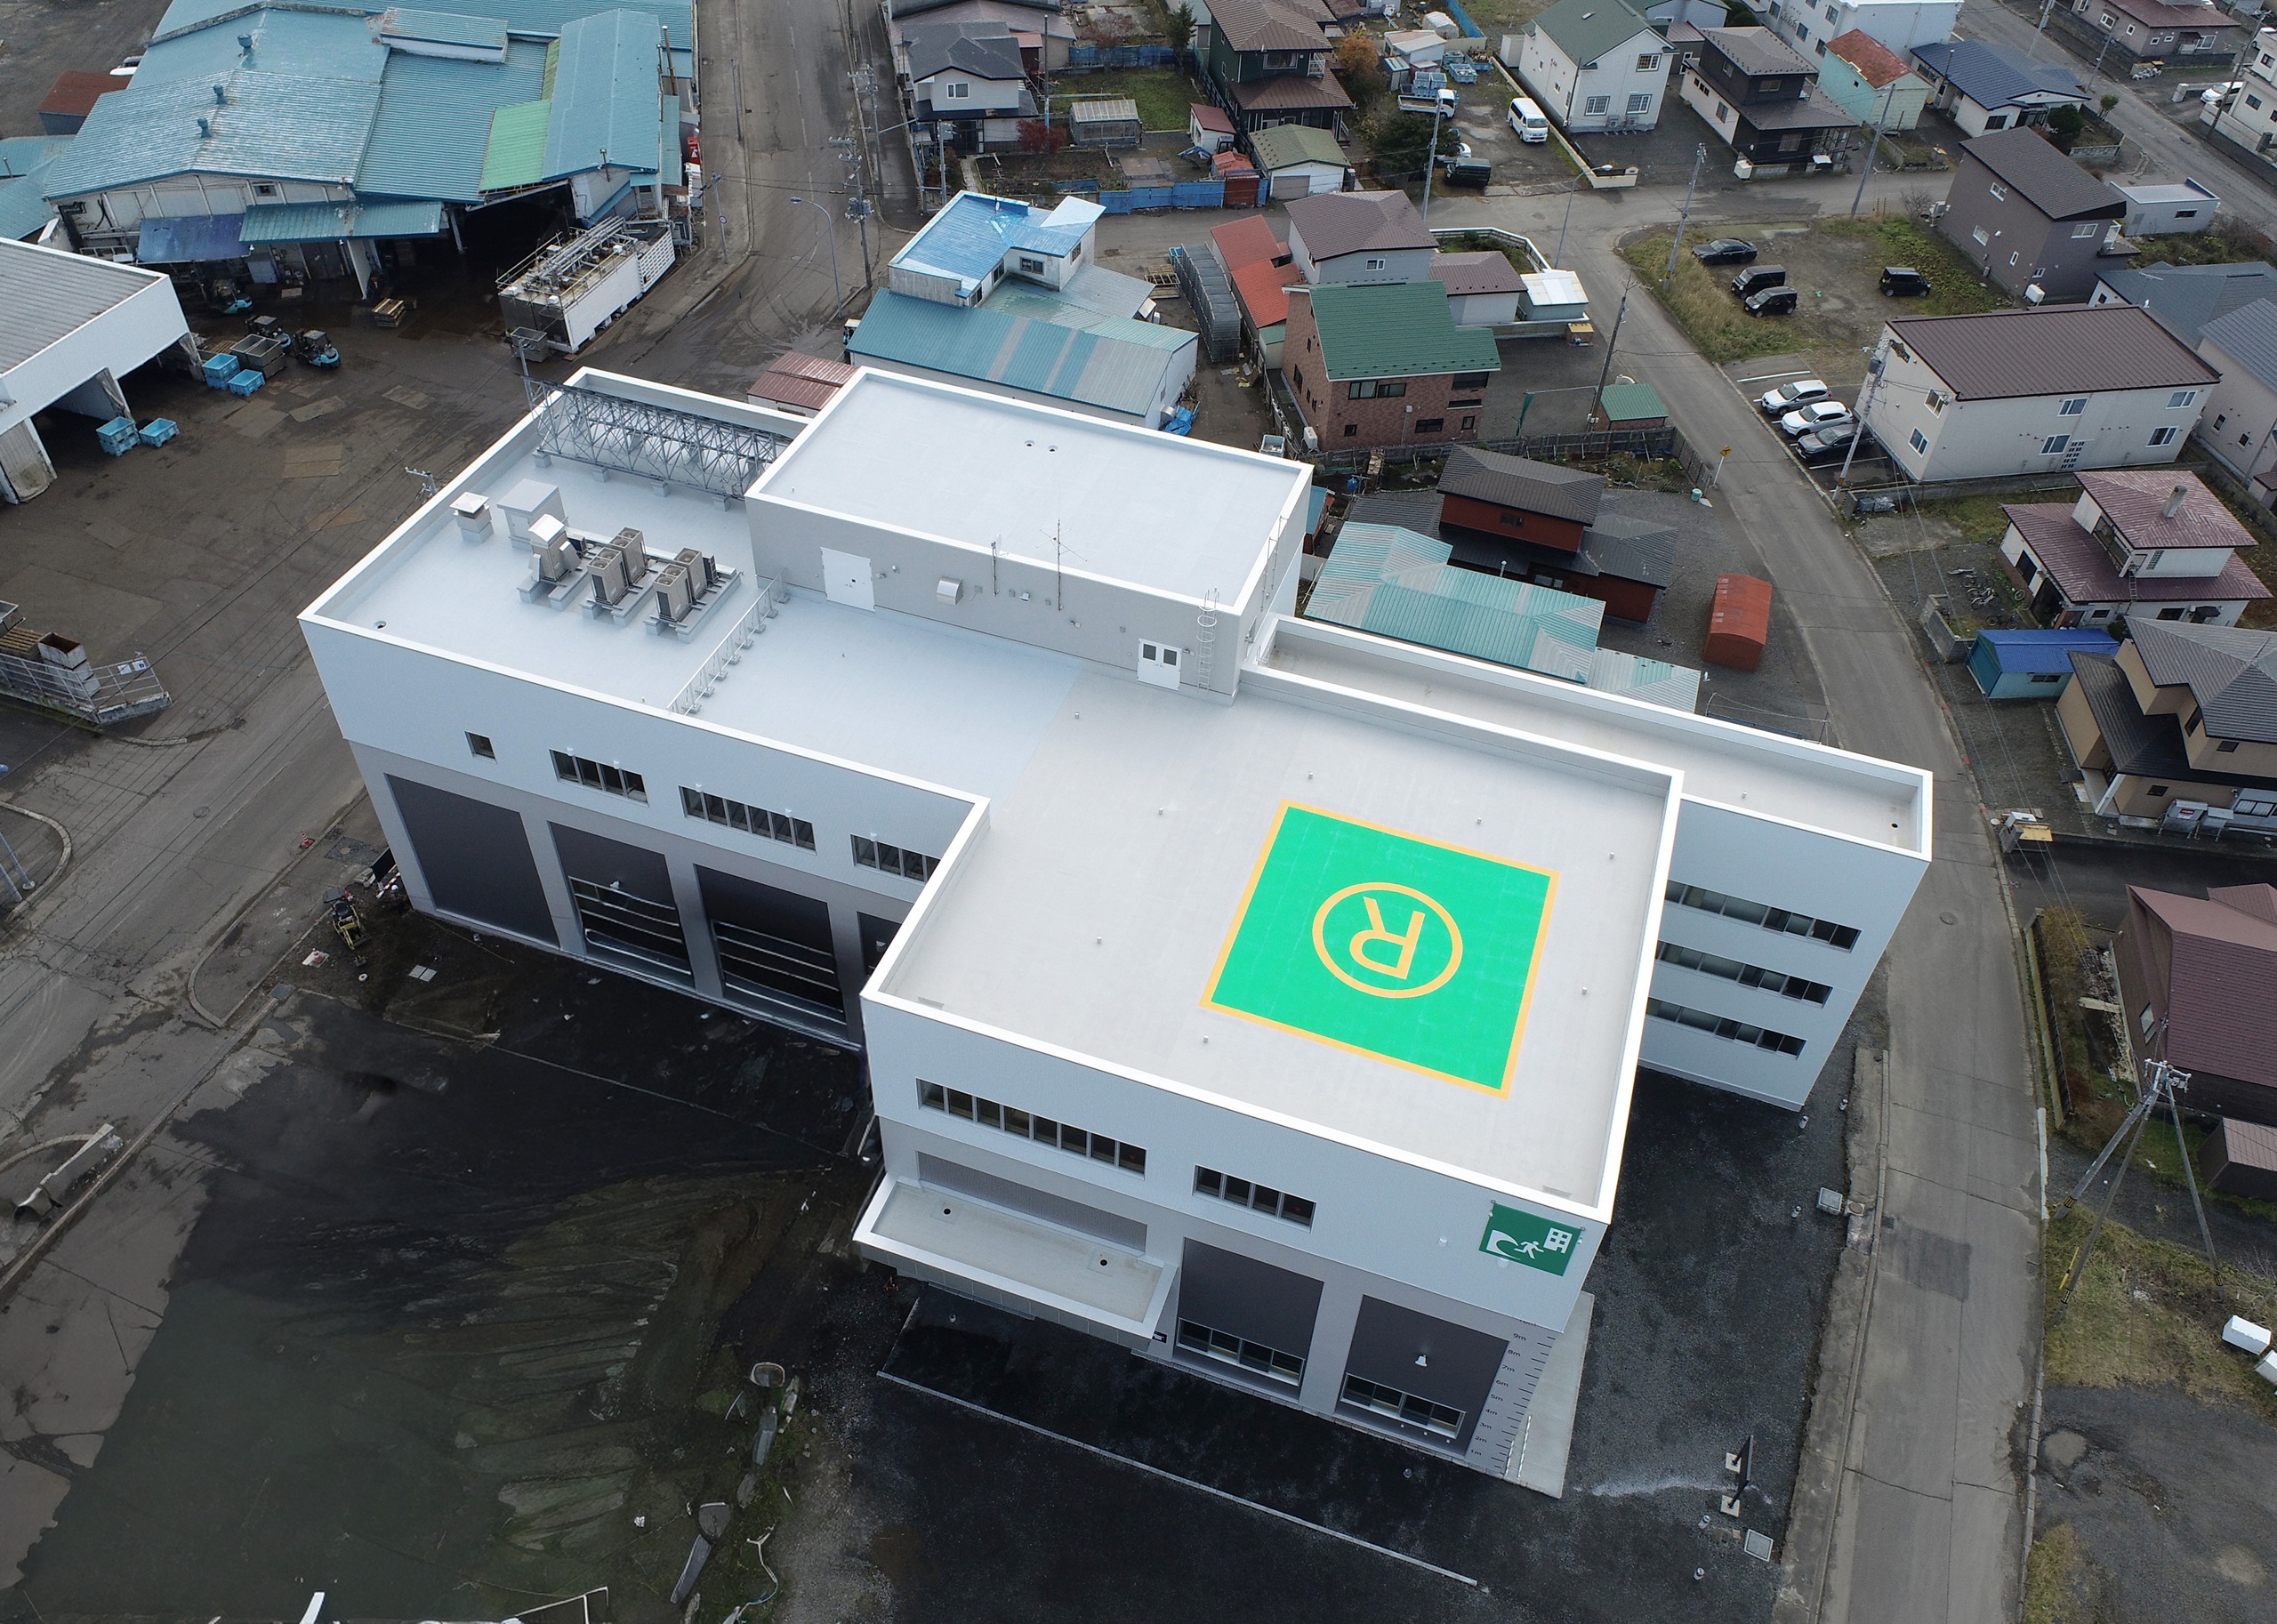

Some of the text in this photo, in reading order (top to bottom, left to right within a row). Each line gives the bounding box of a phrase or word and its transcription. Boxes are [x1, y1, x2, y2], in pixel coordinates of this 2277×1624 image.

[1349, 896, 1425, 979] R
[1513, 1333, 1526, 1341] 9m
[1508, 1349, 1521, 1357] 8m
[1502, 1364, 1515, 1372] 7m
[1496, 1379, 1509, 1387] 6m
[1491, 1394, 1503, 1402] 5m
[1475, 1435, 1487, 1443] 2m
